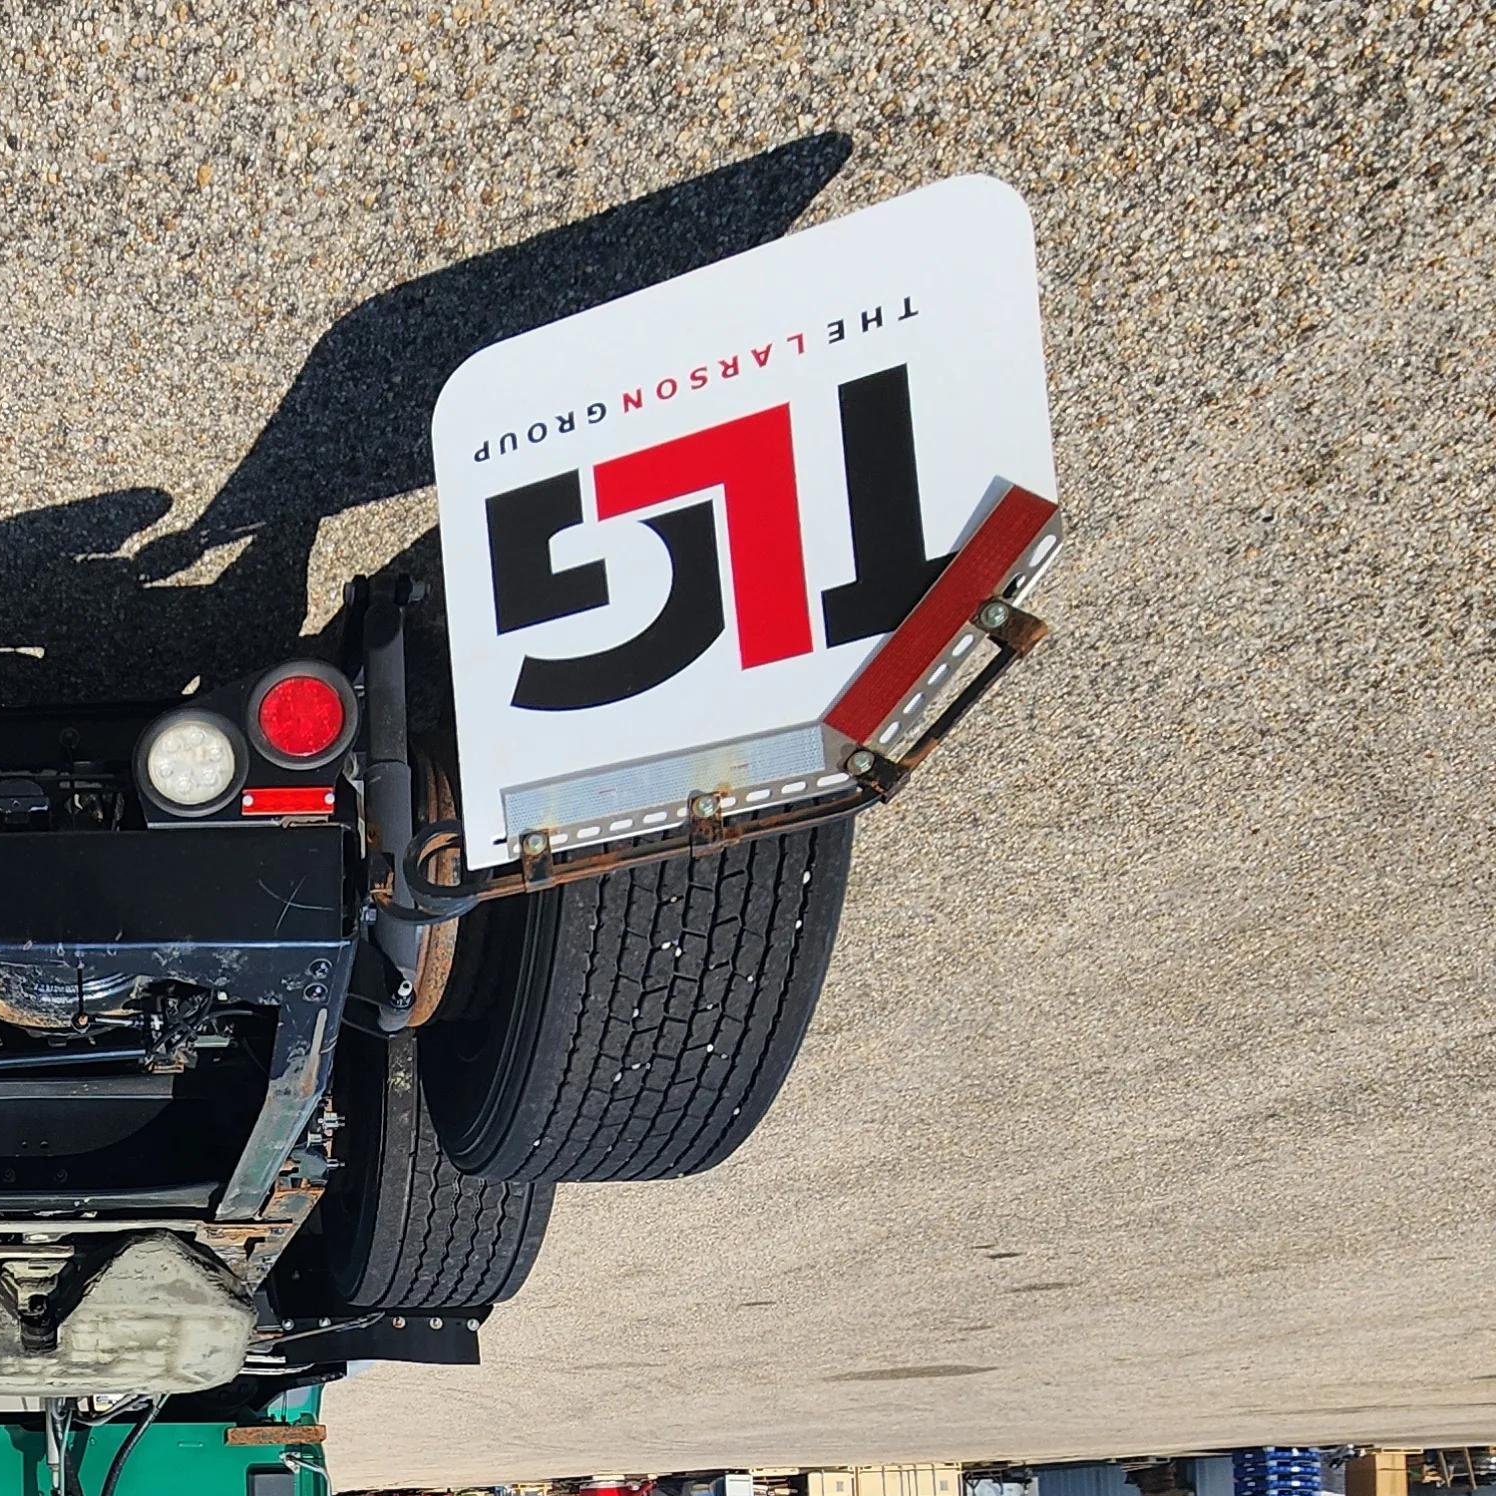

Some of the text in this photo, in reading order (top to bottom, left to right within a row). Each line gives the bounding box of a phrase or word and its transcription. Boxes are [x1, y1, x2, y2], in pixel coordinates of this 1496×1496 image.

[471, 296, 919, 464] THE LARSON GROUP
[485, 364, 958, 713] TLG
